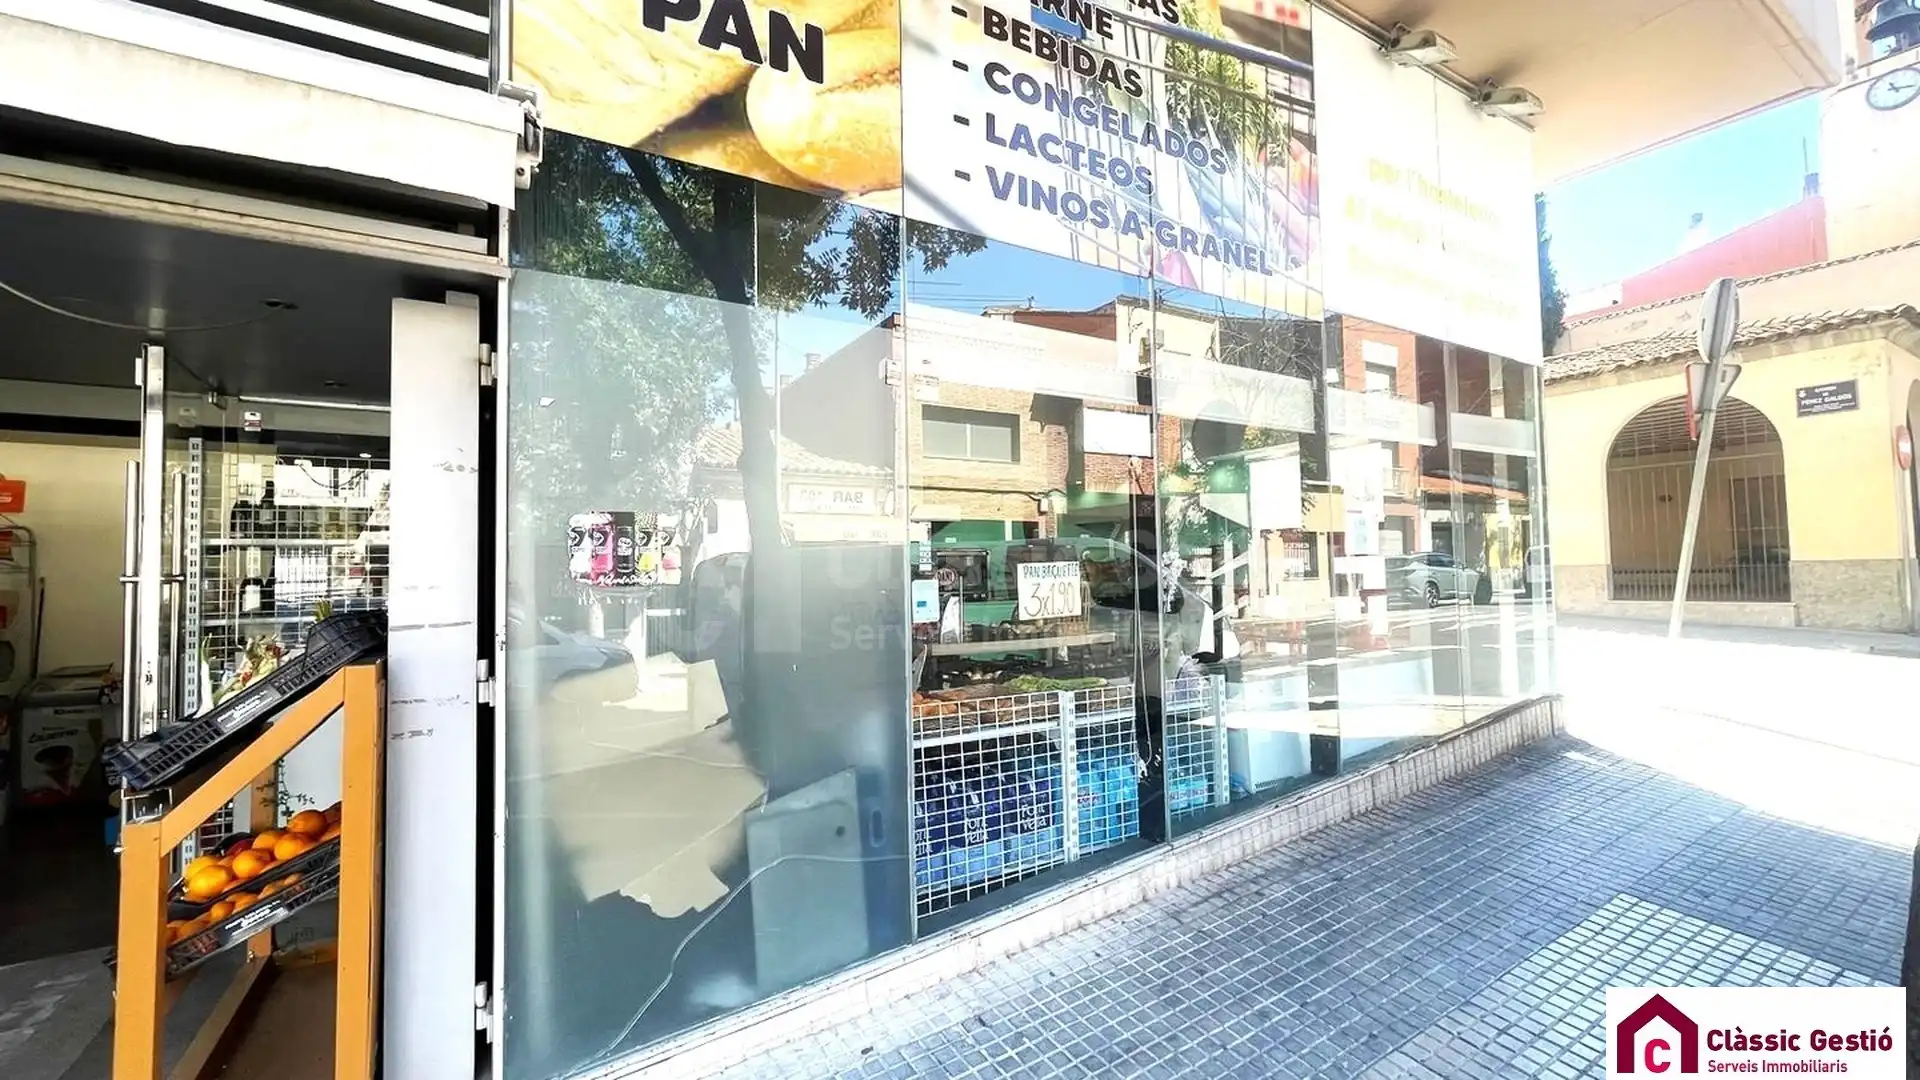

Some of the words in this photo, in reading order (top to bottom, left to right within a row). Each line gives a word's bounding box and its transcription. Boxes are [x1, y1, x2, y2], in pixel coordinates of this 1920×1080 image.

[643, 0, 824, 84] PAN
[983, 5, 1144, 99] BEBIDAS
[983, 61, 1228, 175] CONGELADOS
[985, 112, 1155, 195] LACTEOS
[984, 165, 1112, 230] VINOS
[1121, 210, 1145, 241] A
[1155, 219, 1274, 277] GRANEL
